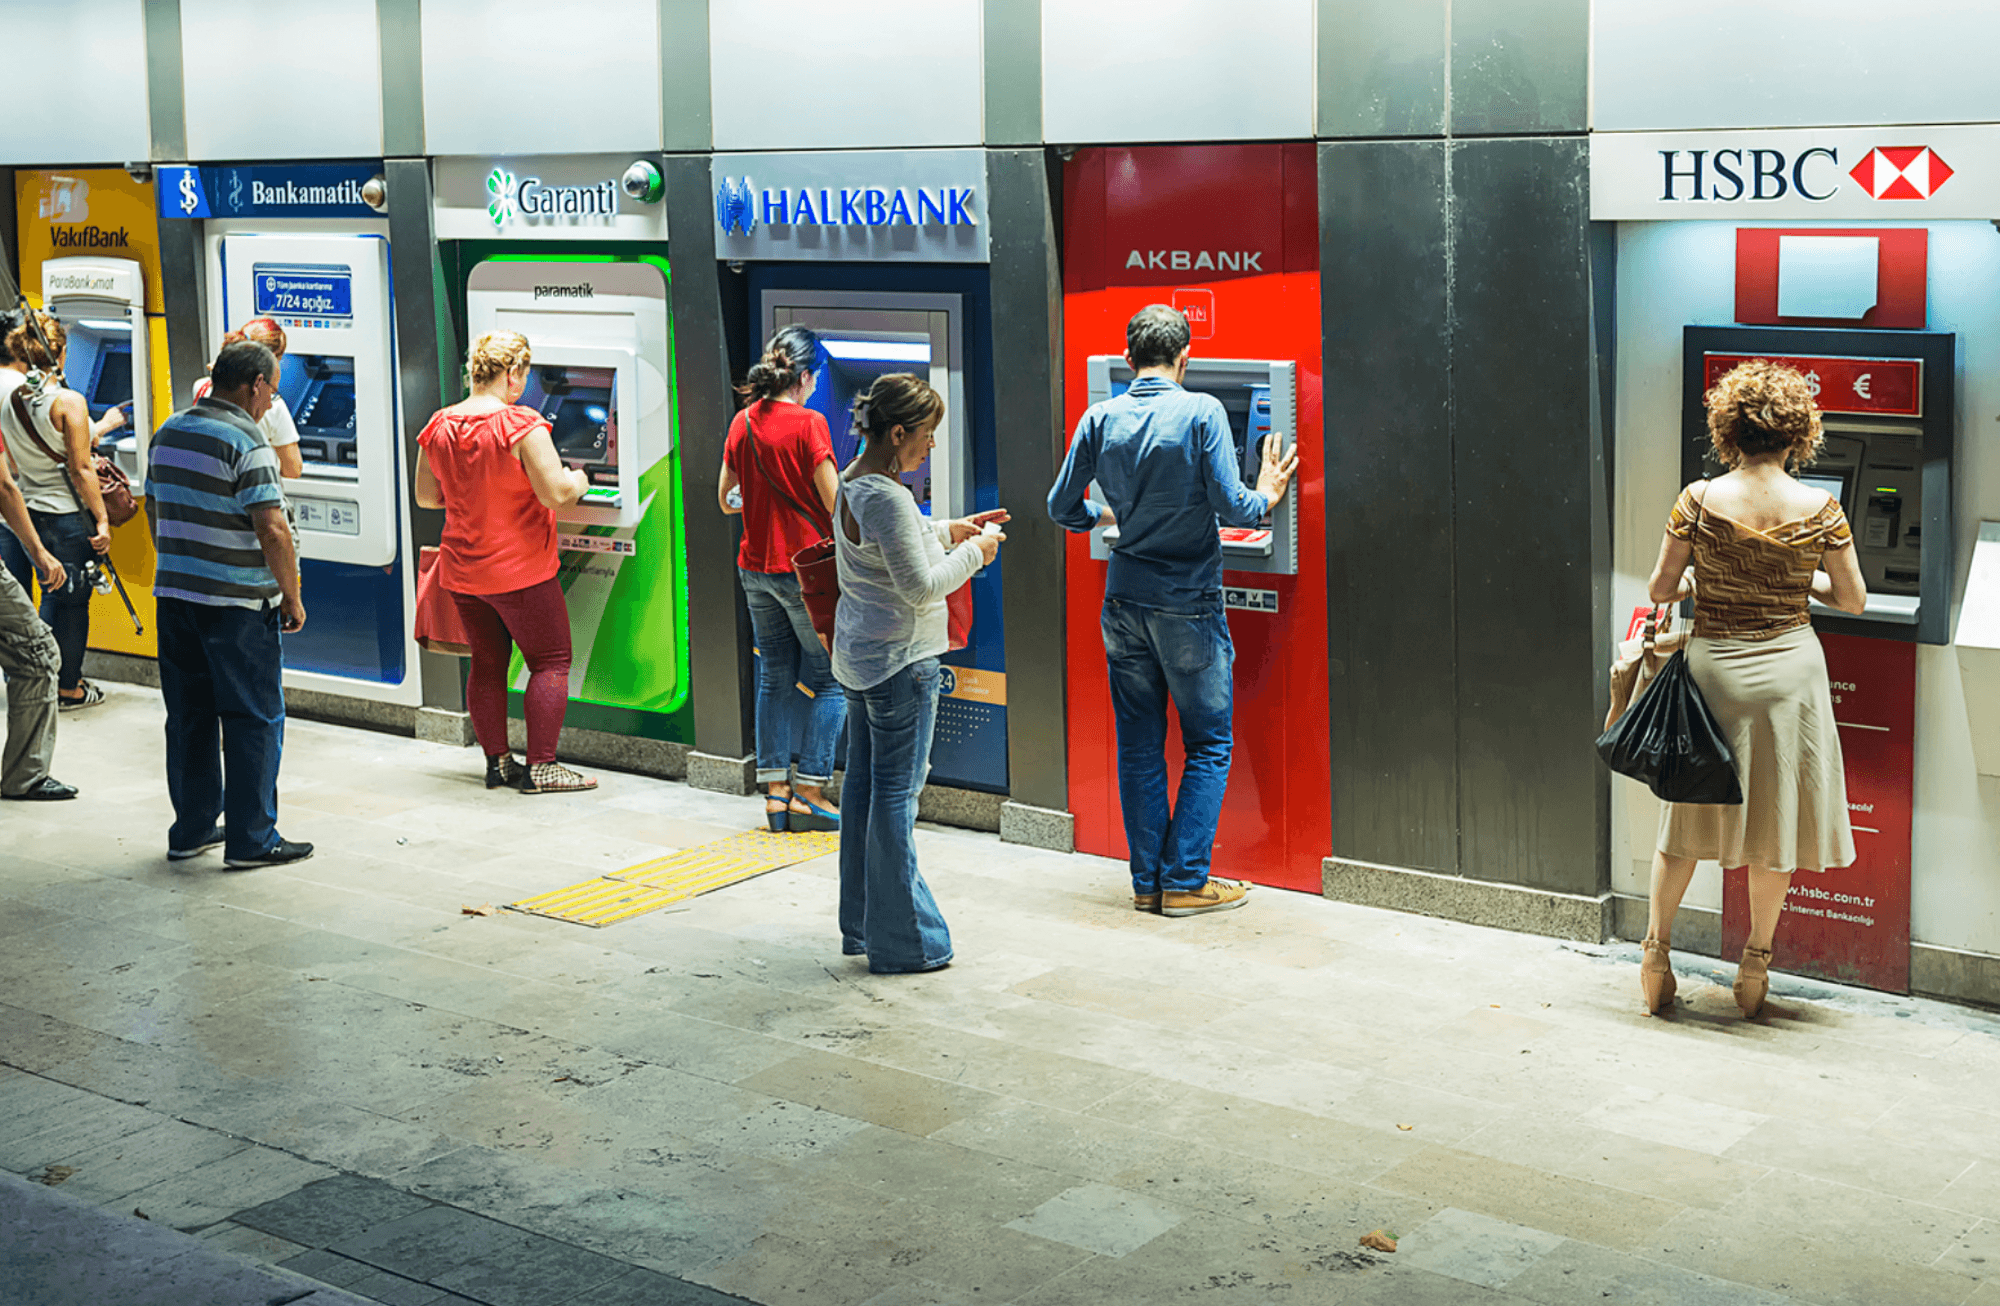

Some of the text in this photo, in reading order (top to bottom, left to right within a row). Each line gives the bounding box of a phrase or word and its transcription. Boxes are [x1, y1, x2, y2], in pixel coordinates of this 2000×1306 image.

[1658, 147, 1839, 201] HSBC
[252, 178, 364, 205] Bankamatik
[518, 178, 616, 214] Garanti
[762, 187, 977, 226] HALKBANK
[1125, 249, 1263, 272] AKBANK
[276, 294, 301, 309] 7/24
[534, 282, 594, 301] paramatik
[938, 673, 953, 690] 24
[1787, 885, 1875, 907] w.hsbc.com.tr
